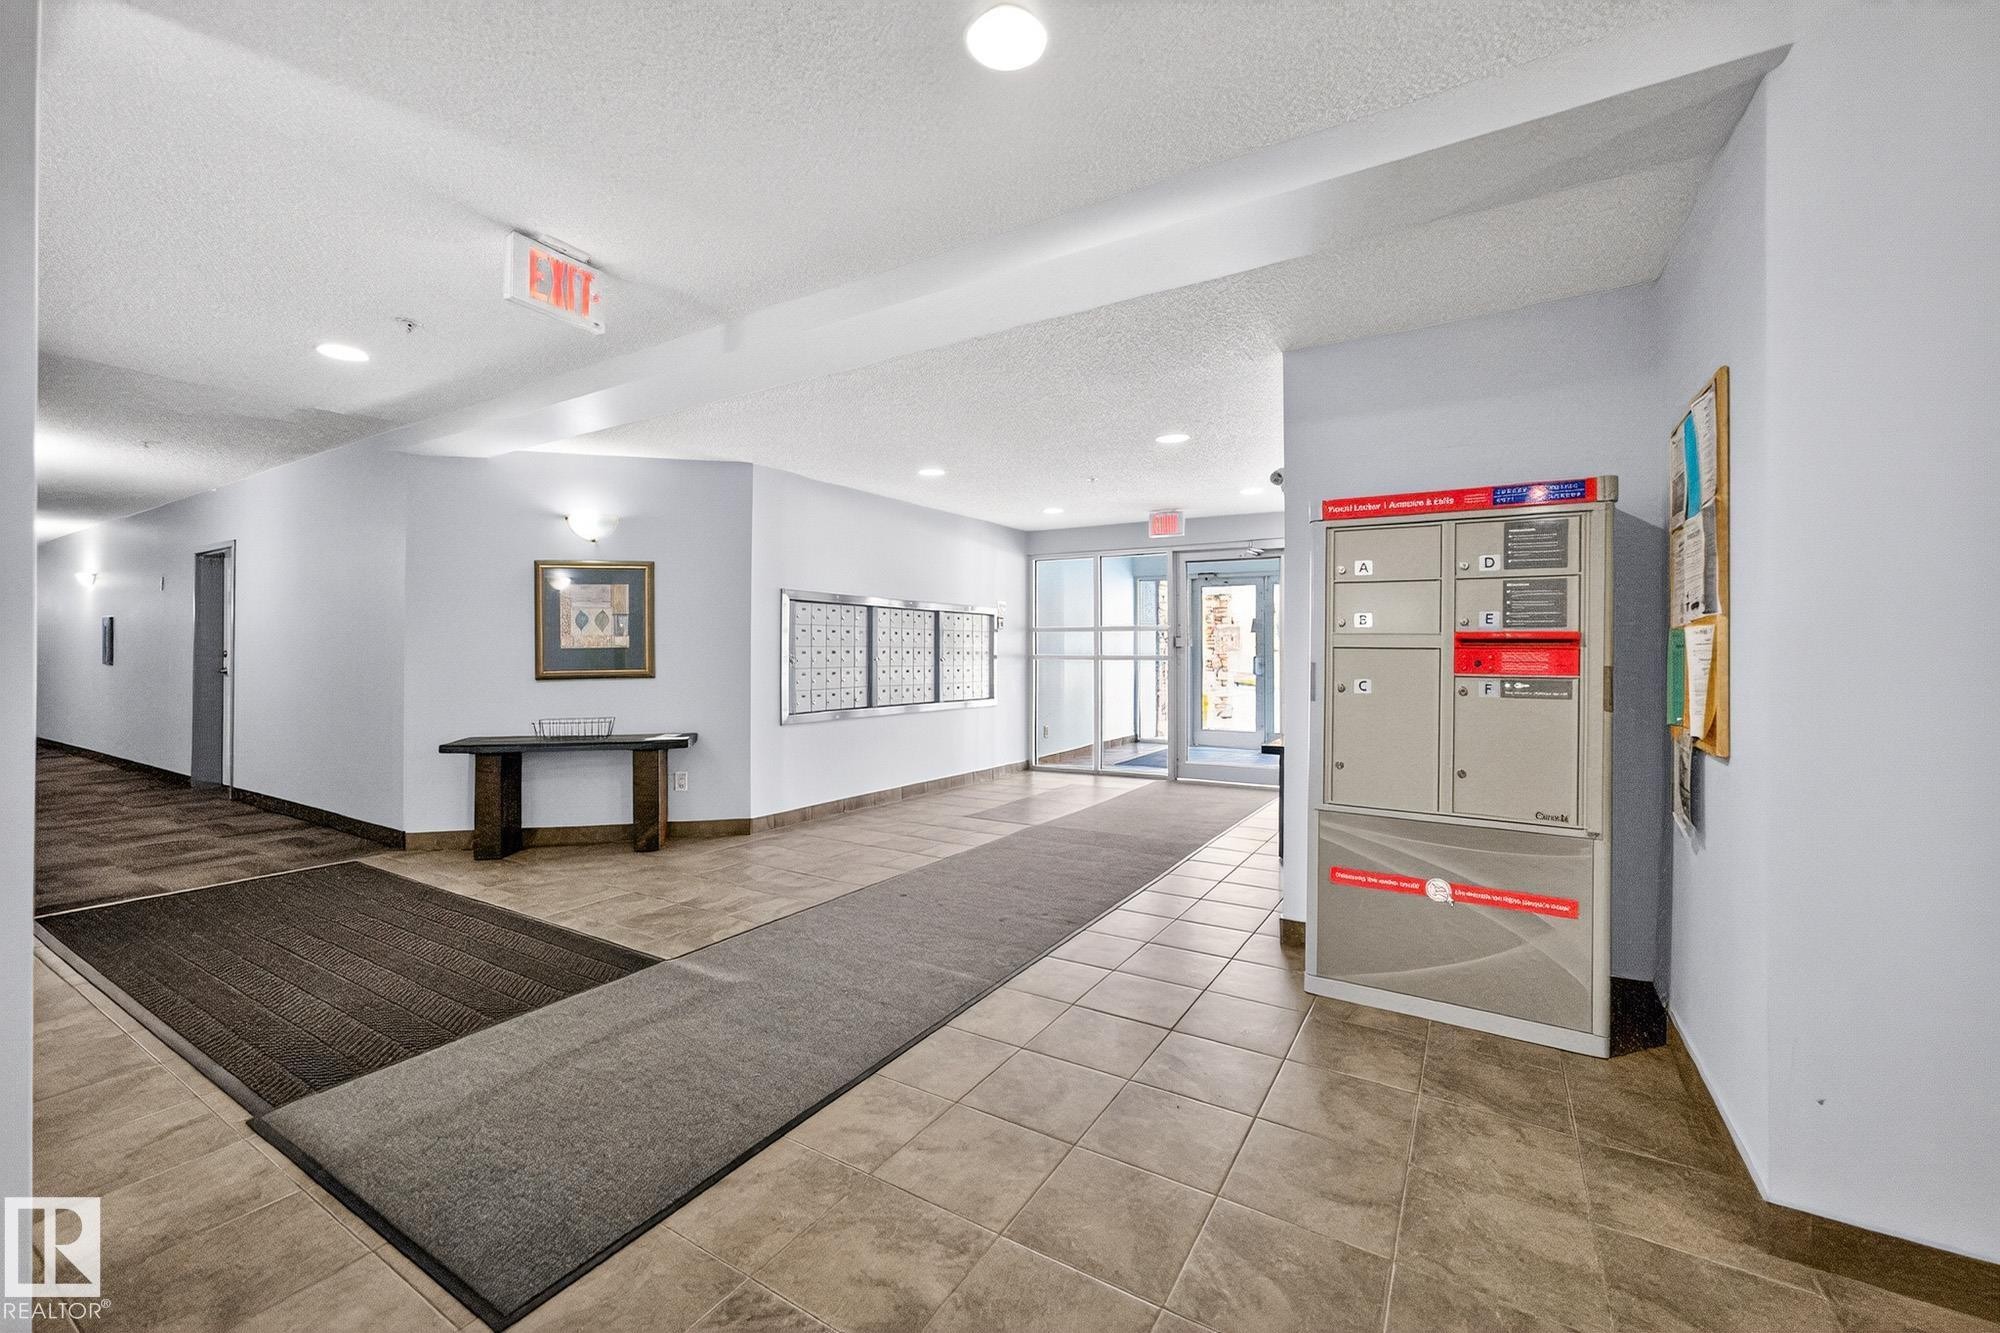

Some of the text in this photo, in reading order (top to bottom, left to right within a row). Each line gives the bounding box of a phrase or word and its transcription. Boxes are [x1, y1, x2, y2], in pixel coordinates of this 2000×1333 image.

[529, 246, 593, 319] EXIT
[1359, 562, 1369, 573] A
[1484, 557, 1495, 568] D
[1359, 614, 1367, 625] B
[1485, 613, 1494, 624] E
[1359, 680, 1368, 691] C
[1485, 683, 1493, 695] F
